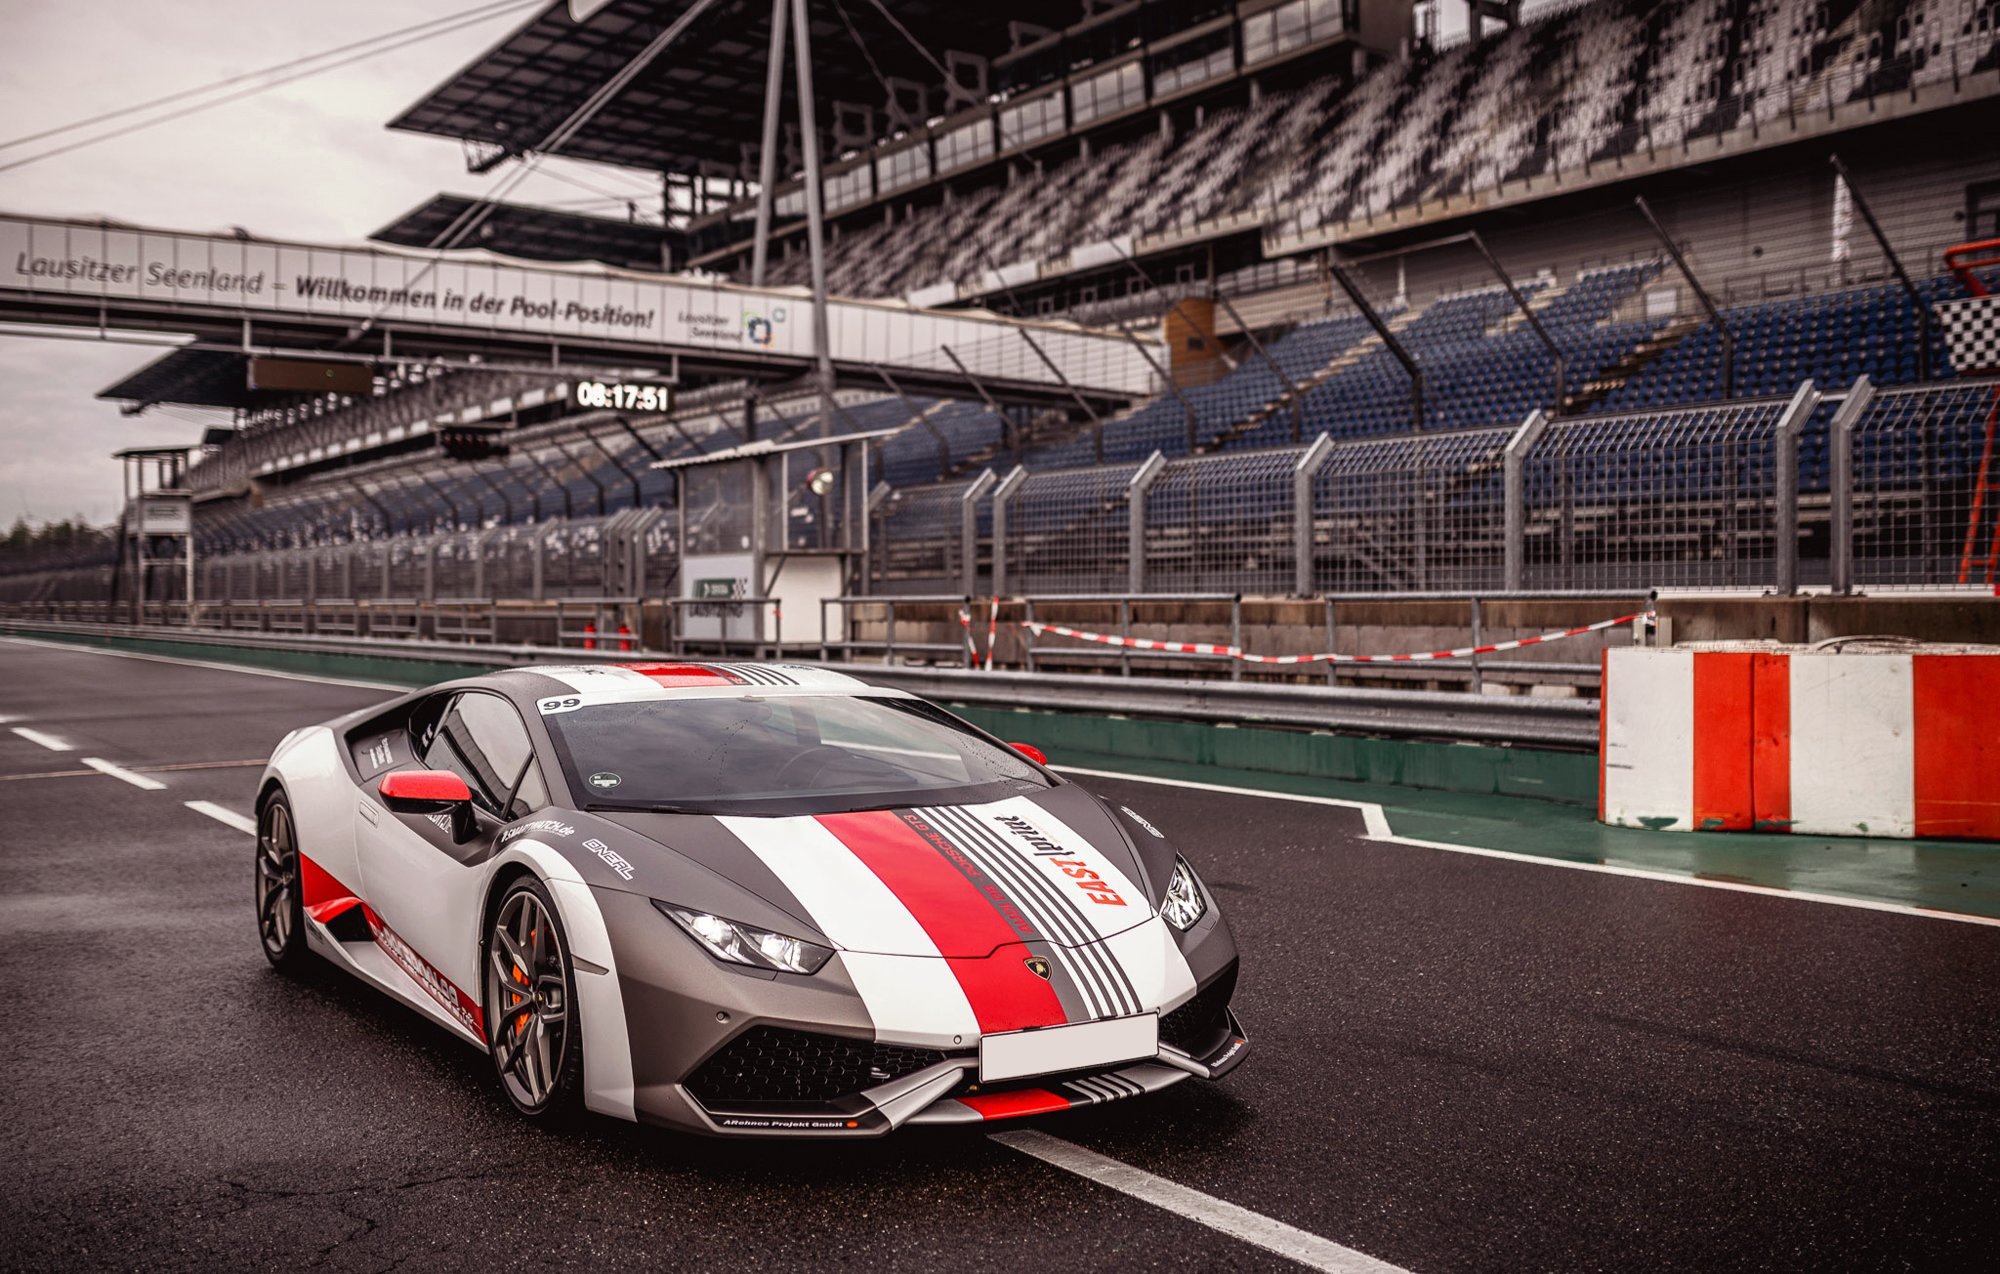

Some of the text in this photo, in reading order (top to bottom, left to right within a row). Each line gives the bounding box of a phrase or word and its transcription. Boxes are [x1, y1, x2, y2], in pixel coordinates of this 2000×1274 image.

[15, 251, 138, 284] Lausitzer
[145, 262, 265, 294] Seenland
[296, 275, 437, 308] Willkommen
[442, 288, 463, 311] in
[470, 291, 505, 315] der
[510, 296, 655, 330] Pool-Position!
[543, 698, 581, 710] 99
[902, 813, 930, 831] GT3
[924, 831, 982, 877] PORSCHE
[982, 885, 1005, 901] R8
[998, 902, 1035, 933] AUDI
[771, 1120, 810, 1128] Projekt
